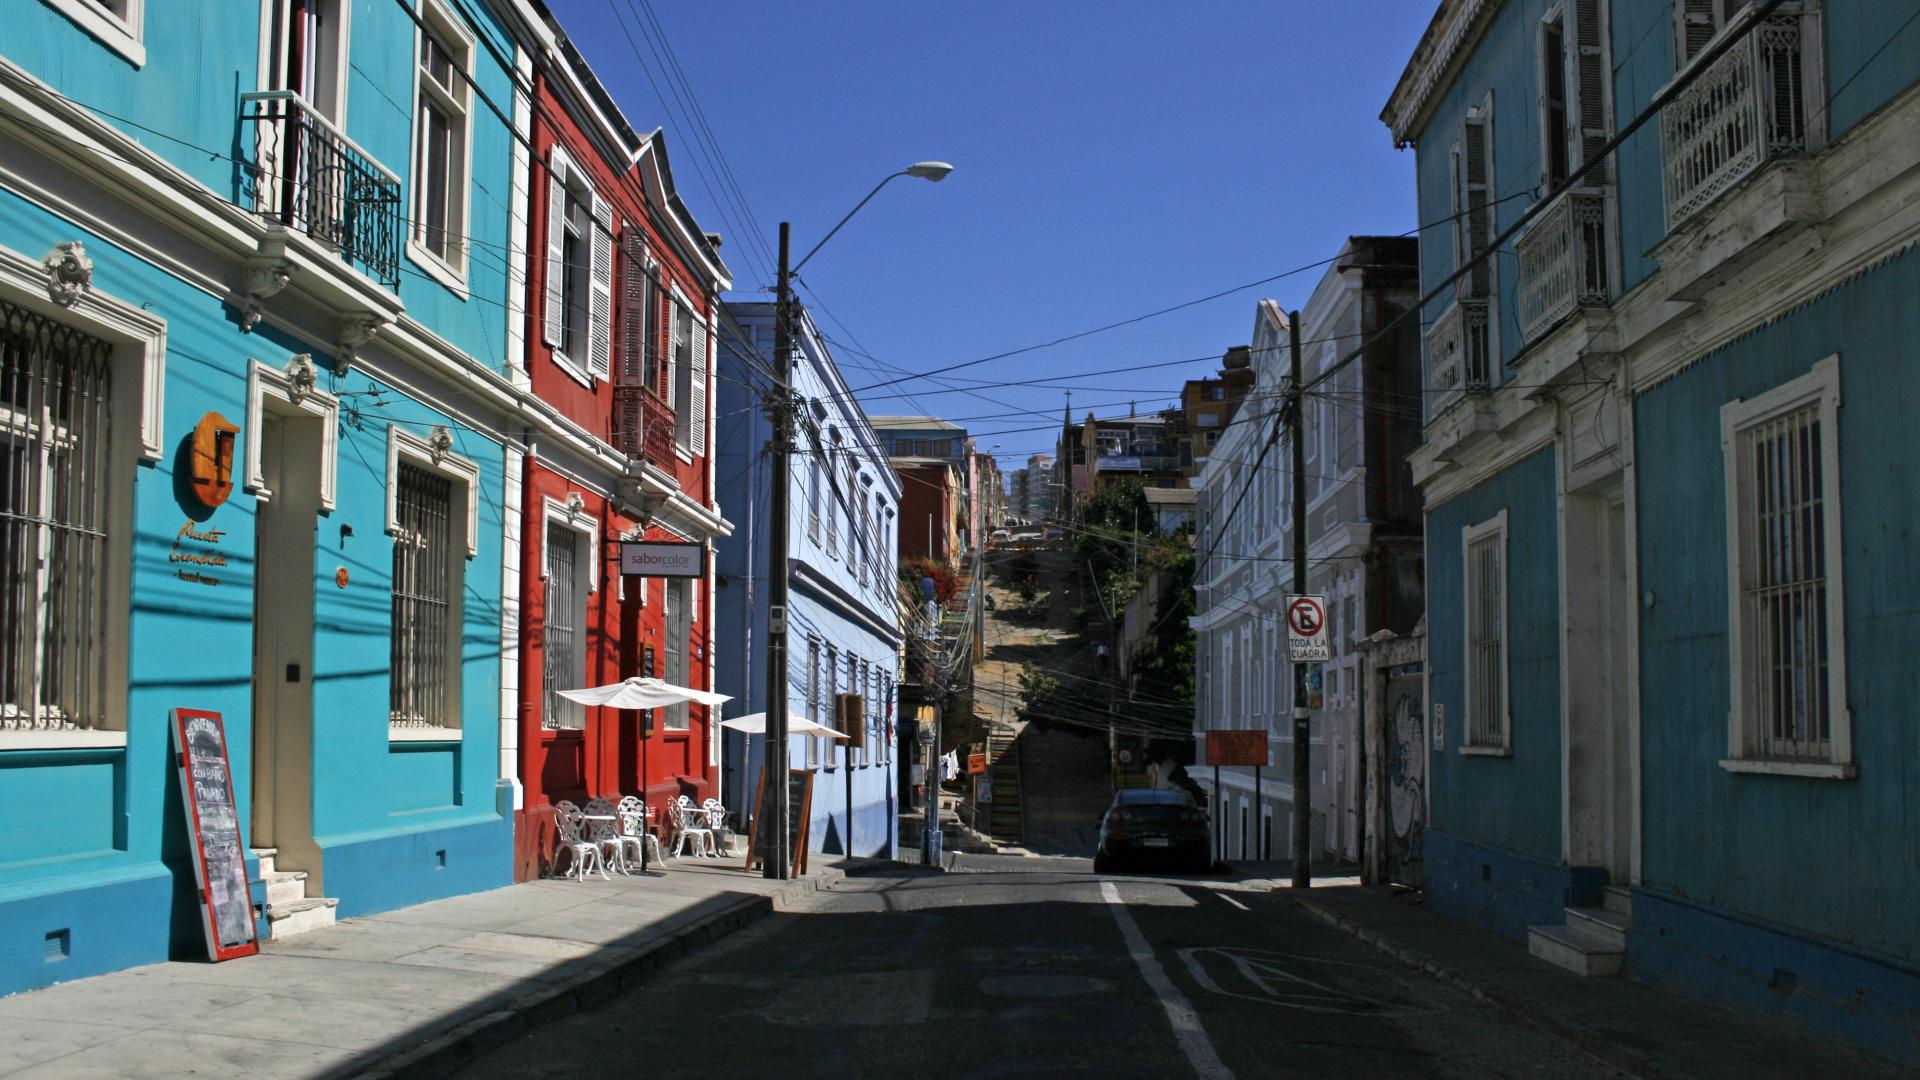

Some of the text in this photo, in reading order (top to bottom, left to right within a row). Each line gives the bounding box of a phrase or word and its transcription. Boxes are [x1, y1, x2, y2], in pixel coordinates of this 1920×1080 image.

[631, 552, 691, 565] saborcolor
[1290, 638, 1327, 648] TODA LA
[1291, 649, 1327, 659] CUADRA
